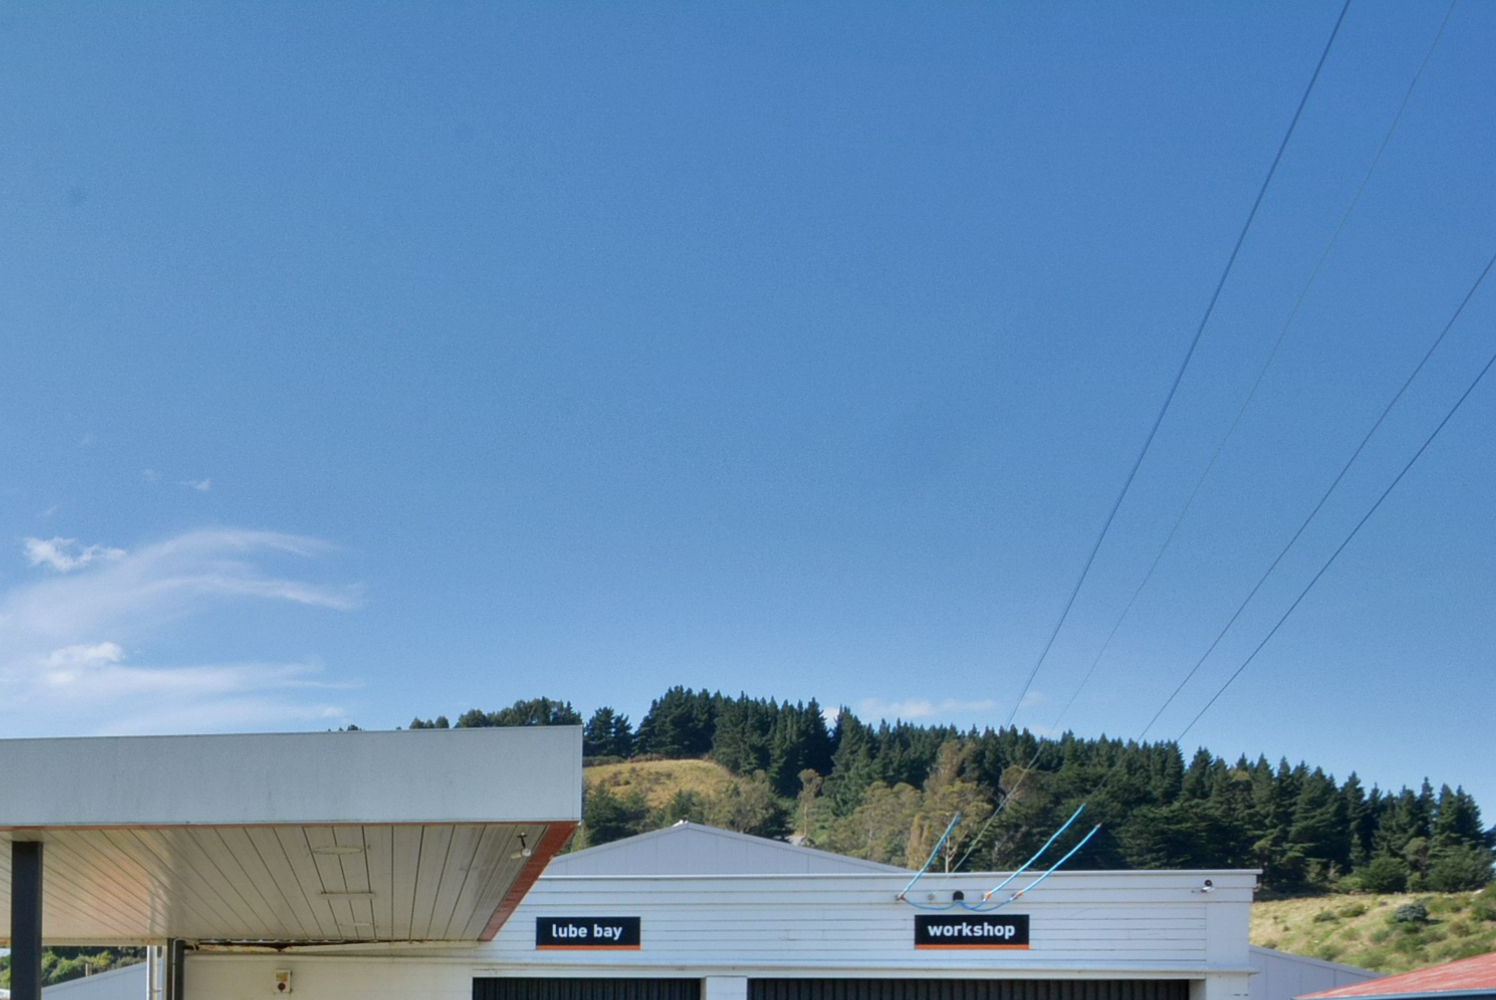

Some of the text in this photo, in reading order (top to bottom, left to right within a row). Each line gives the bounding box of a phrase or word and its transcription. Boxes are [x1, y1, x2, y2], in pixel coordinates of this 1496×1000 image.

[552, 923, 623, 941] lube bay
[927, 922, 1016, 940] workshop
